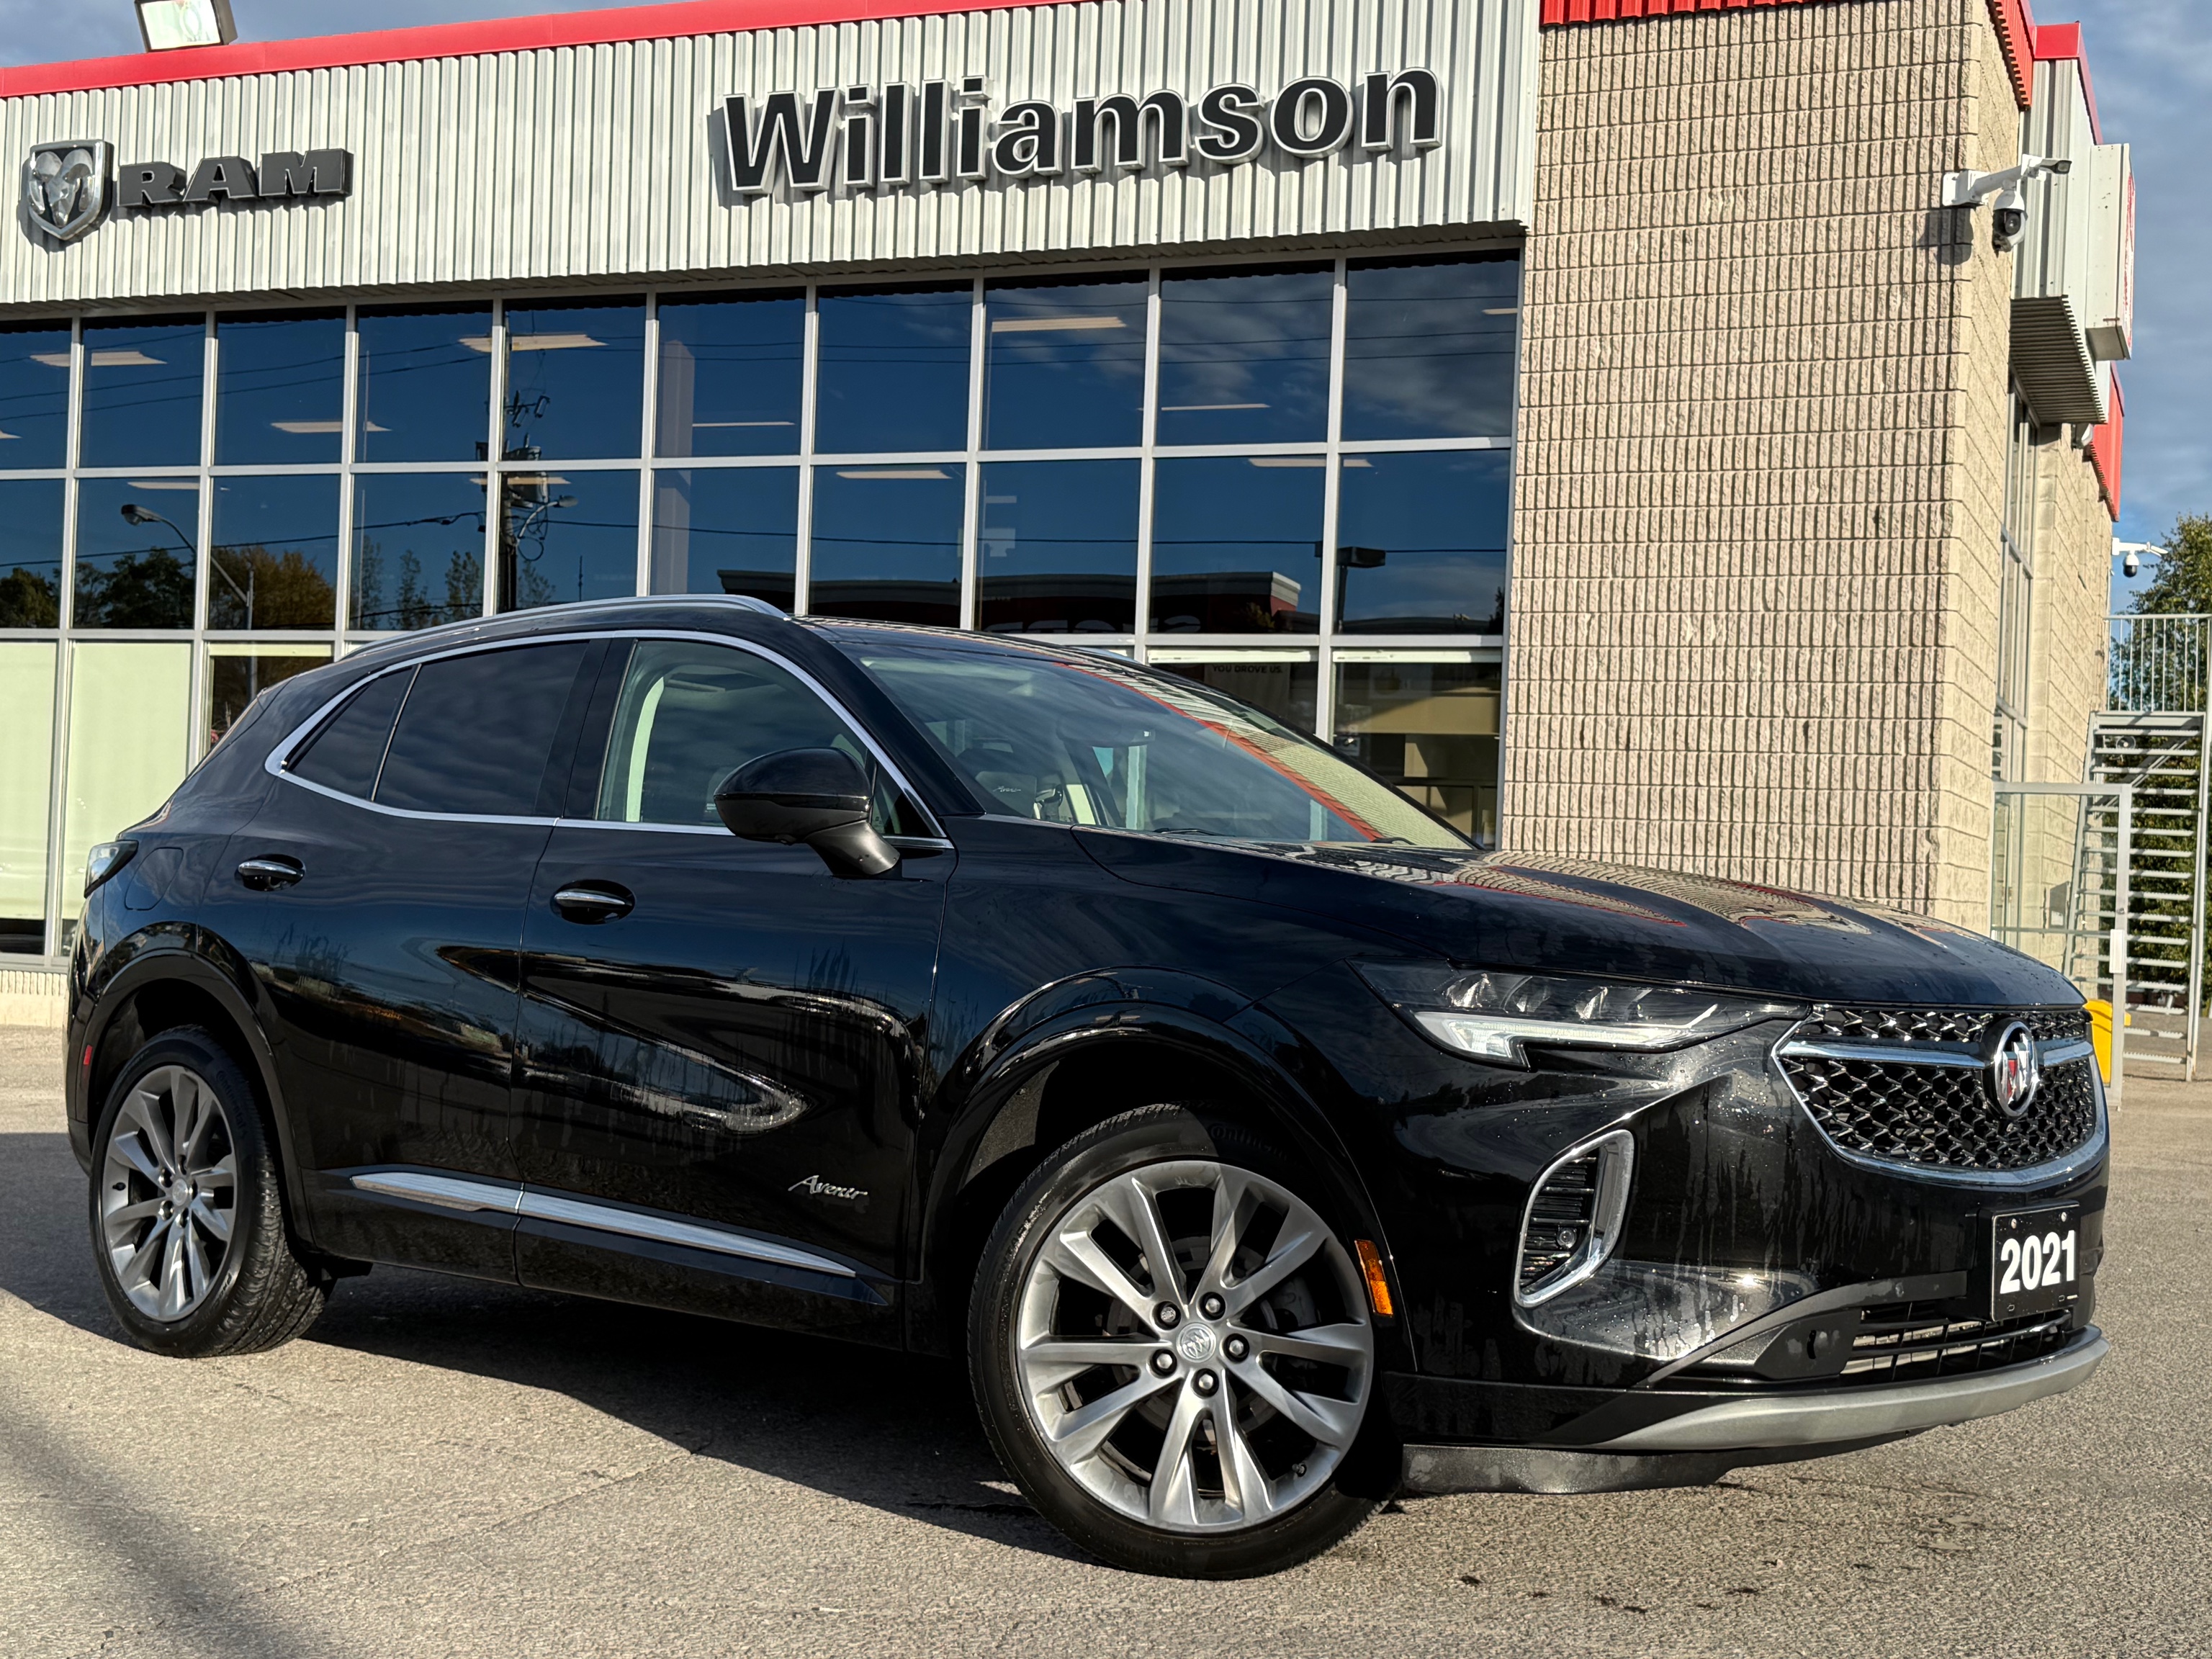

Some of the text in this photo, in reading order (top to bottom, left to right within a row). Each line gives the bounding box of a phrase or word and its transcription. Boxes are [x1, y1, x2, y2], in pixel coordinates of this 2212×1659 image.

[723, 67, 1442, 194] Williamson
[117, 148, 353, 208] RAM
[1234, 665, 1267, 673] DROVE
[788, 1174, 868, 1200] Avenir
[2000, 1230, 2076, 1294] 2021
